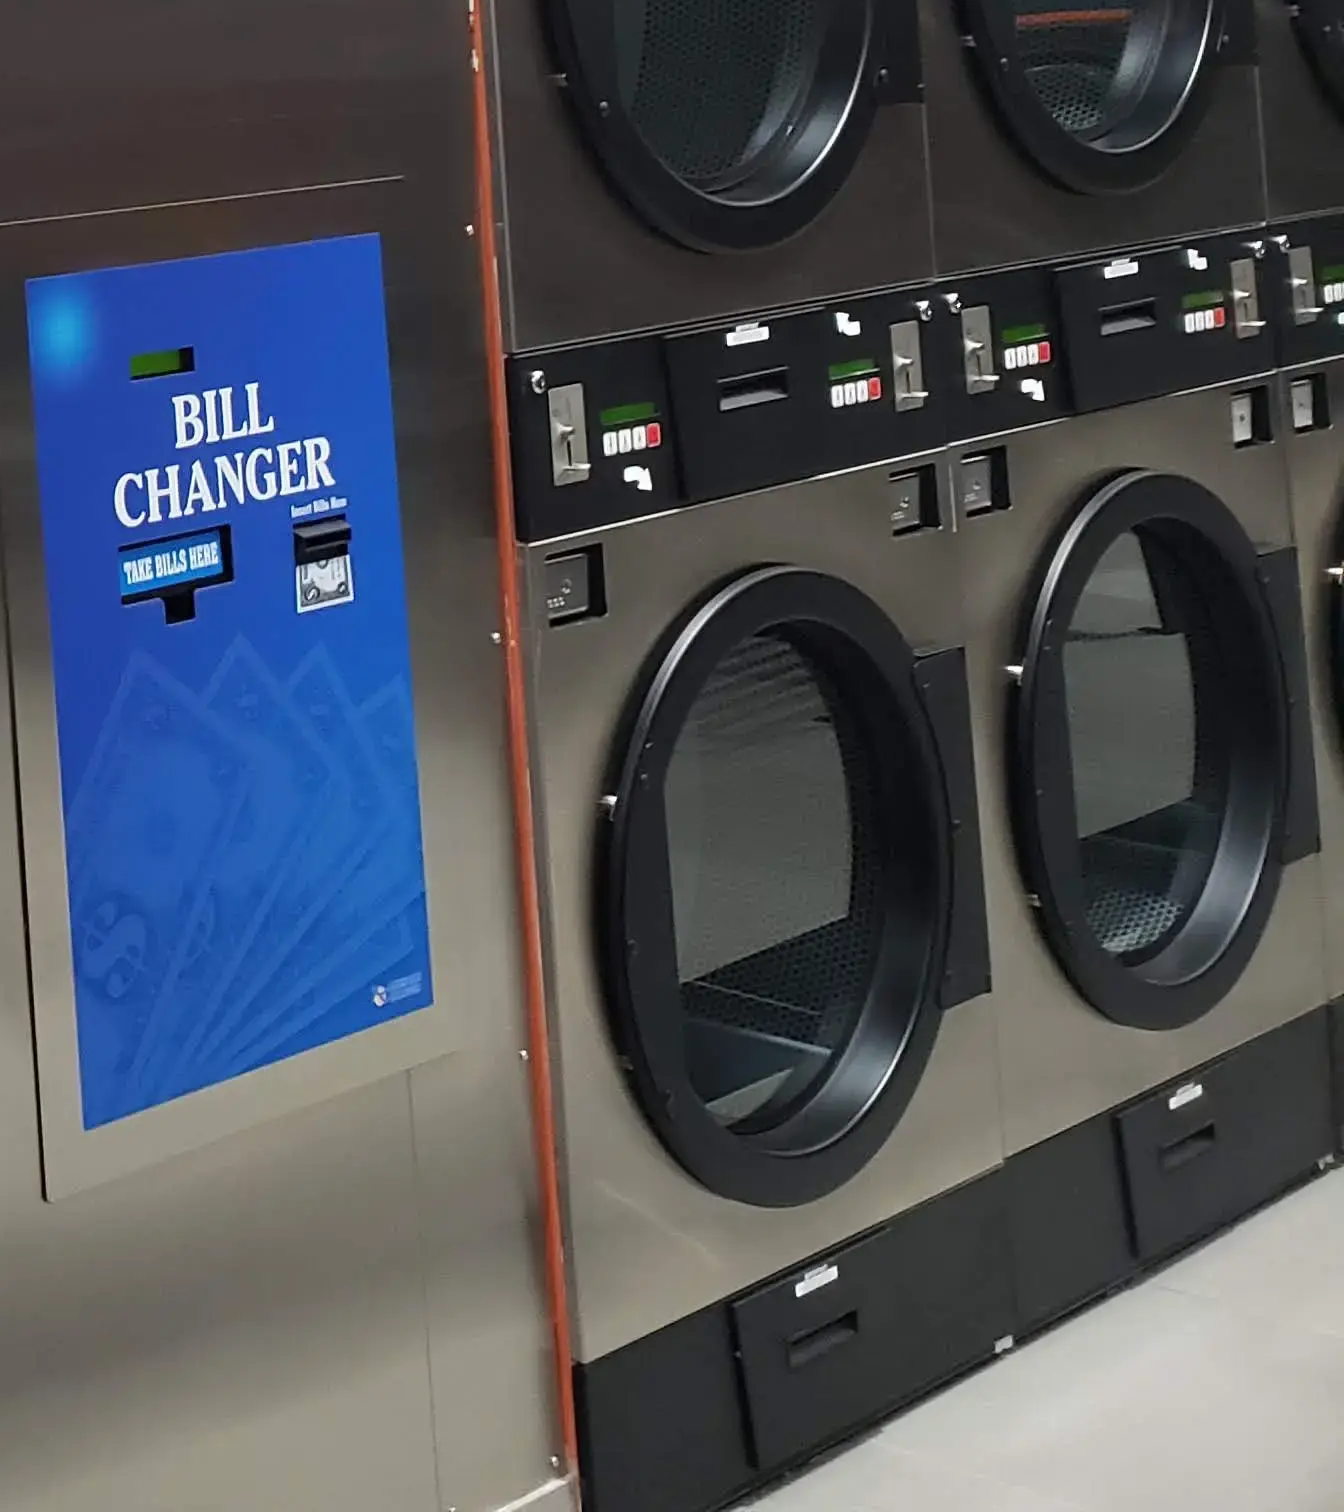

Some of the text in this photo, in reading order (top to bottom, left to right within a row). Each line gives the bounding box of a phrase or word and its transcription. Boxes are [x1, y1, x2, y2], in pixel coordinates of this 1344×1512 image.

[172, 381, 275, 449] BILL
[114, 436, 336, 528] CHANGER
[123, 541, 219, 585] TAKE BILLS HERE
